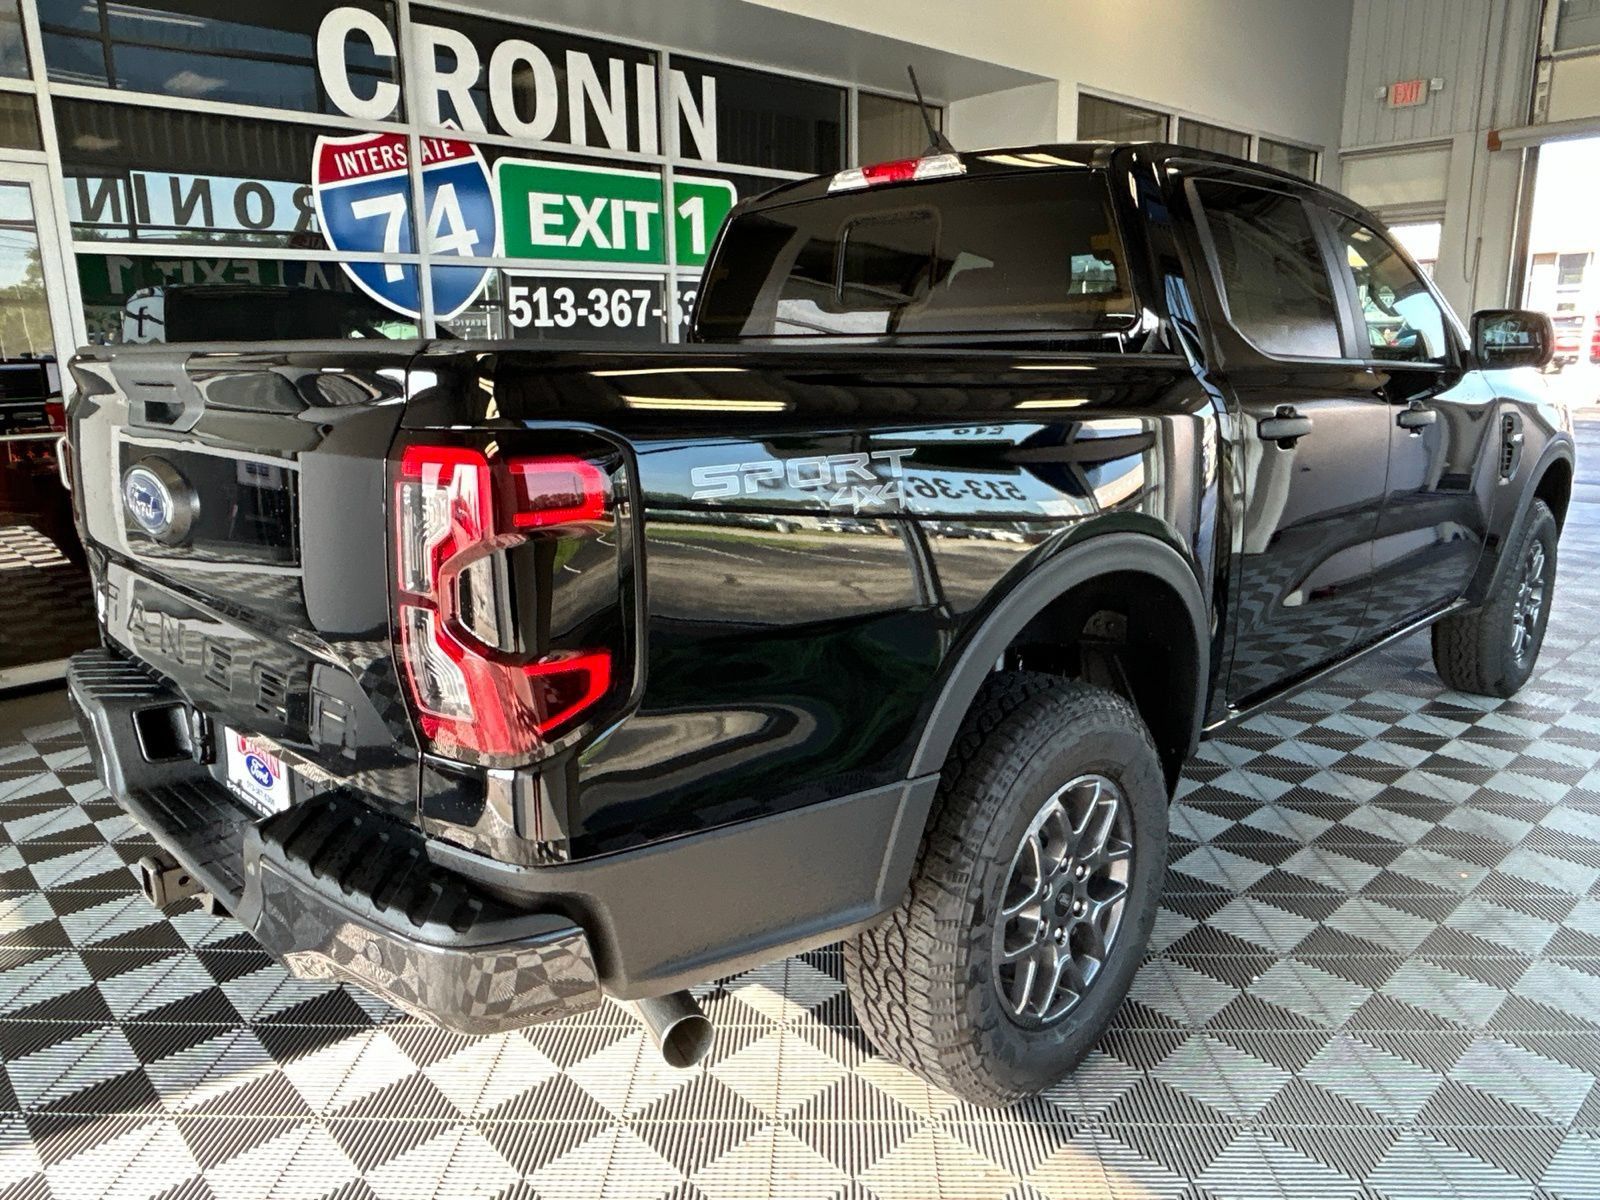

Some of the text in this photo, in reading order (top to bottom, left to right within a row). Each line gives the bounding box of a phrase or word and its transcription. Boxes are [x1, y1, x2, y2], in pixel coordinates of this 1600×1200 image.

[316, 6, 718, 162] CRONIN
[1392, 81, 1422, 105] EXIT
[334, 139, 455, 177] INTERSATE
[351, 183, 480, 283] 74
[528, 191, 706, 255] EXIT 1
[691, 448, 915, 500] SPORT
[248, 756, 272, 786] Ford
